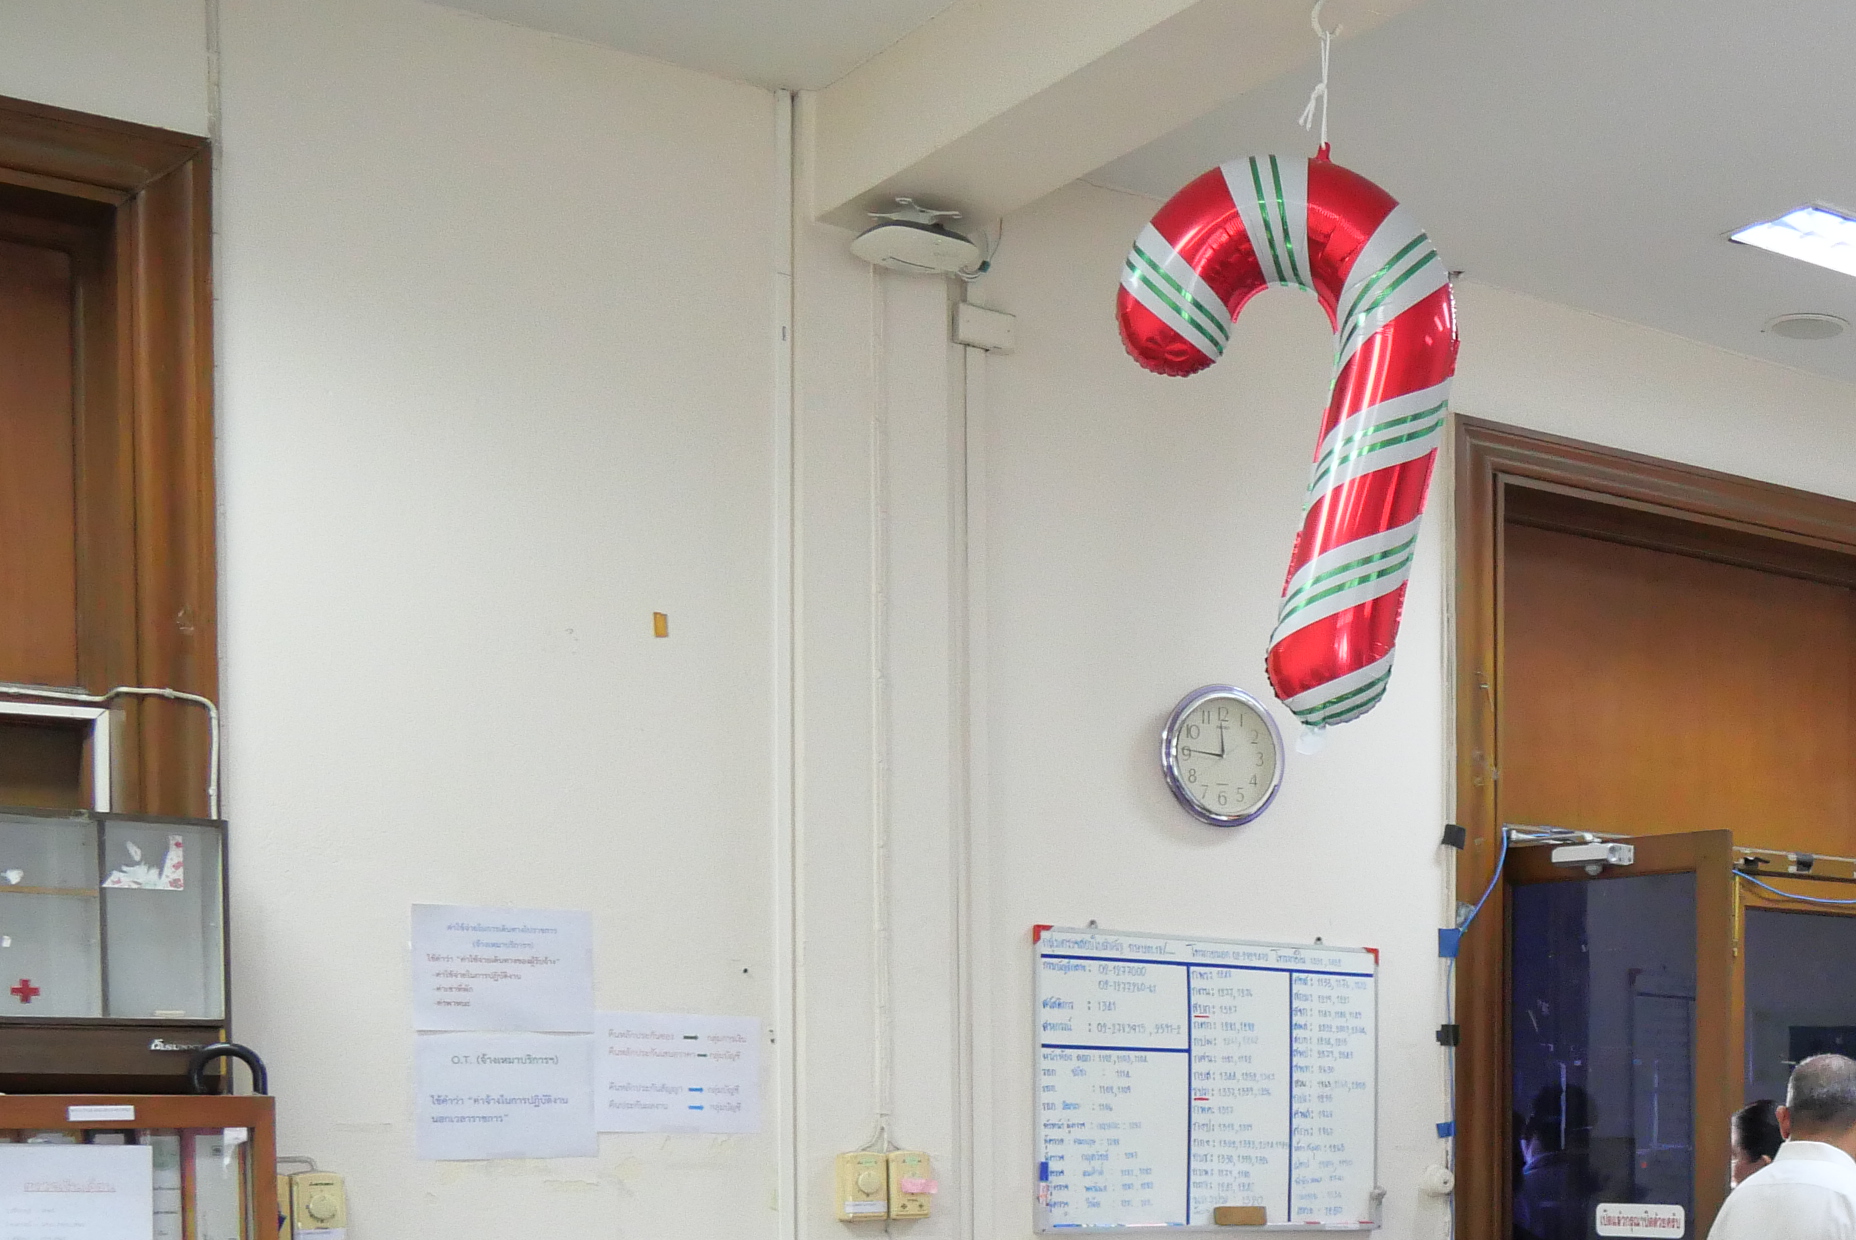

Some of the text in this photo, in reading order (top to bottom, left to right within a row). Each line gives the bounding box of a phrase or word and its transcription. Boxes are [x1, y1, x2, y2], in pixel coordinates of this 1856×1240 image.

[1201, 710, 1210, 724] 11
[1217, 706, 1229, 722] 12
[1239, 713, 1243, 727] 1
[1186, 724, 1200, 740] 10
[1251, 729, 1259, 744] 2
[1181, 746, 1192, 761] 9
[1256, 752, 1264, 767] 3
[1188, 768, 1197, 783] 8
[1249, 774, 1257, 786] 4
[1201, 784, 1209, 799] 7
[1217, 791, 1228, 806] 6
[1236, 787, 1244, 803] 5
[451, 1055, 473, 1065] O.T.
